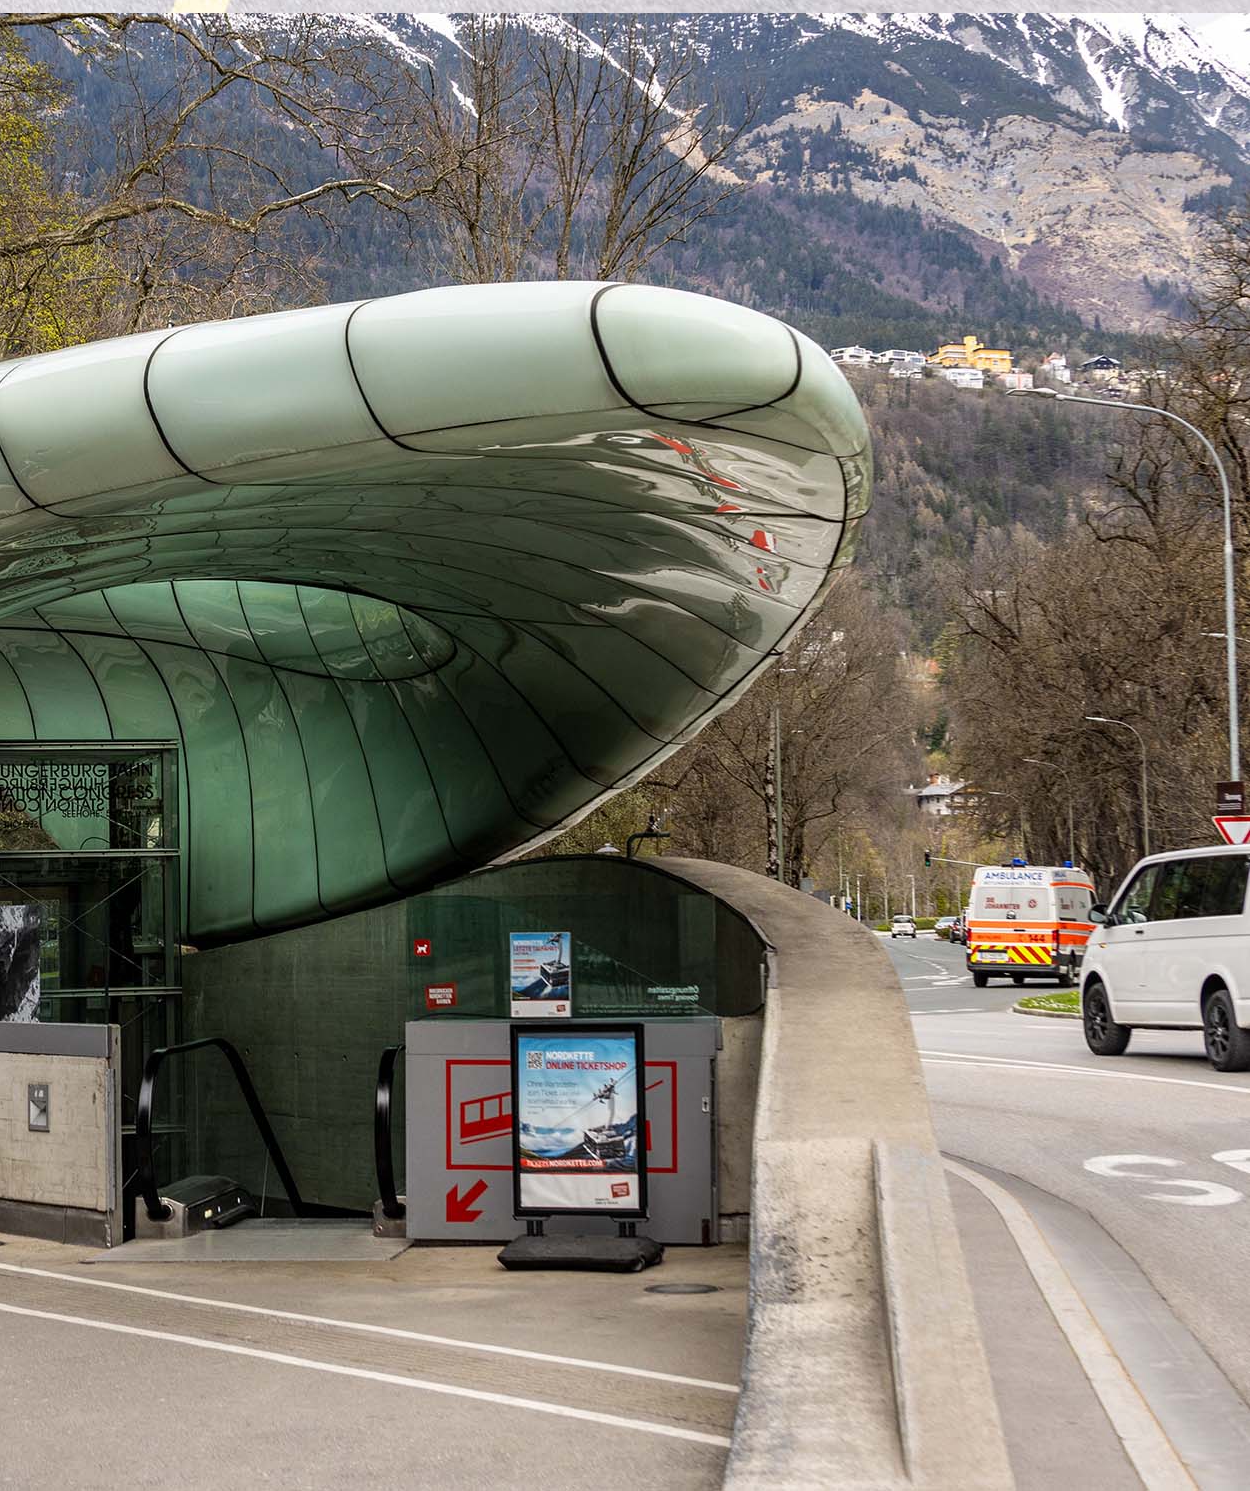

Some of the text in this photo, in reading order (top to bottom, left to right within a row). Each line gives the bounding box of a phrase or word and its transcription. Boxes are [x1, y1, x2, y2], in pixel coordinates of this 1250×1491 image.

[984, 871, 1043, 881] AMBULANCE
[1028, 934, 1045, 942] 144
[546, 1051, 595, 1060] NORDKETTE
[546, 1061, 628, 1070] ONLINE TICKETSHOP
